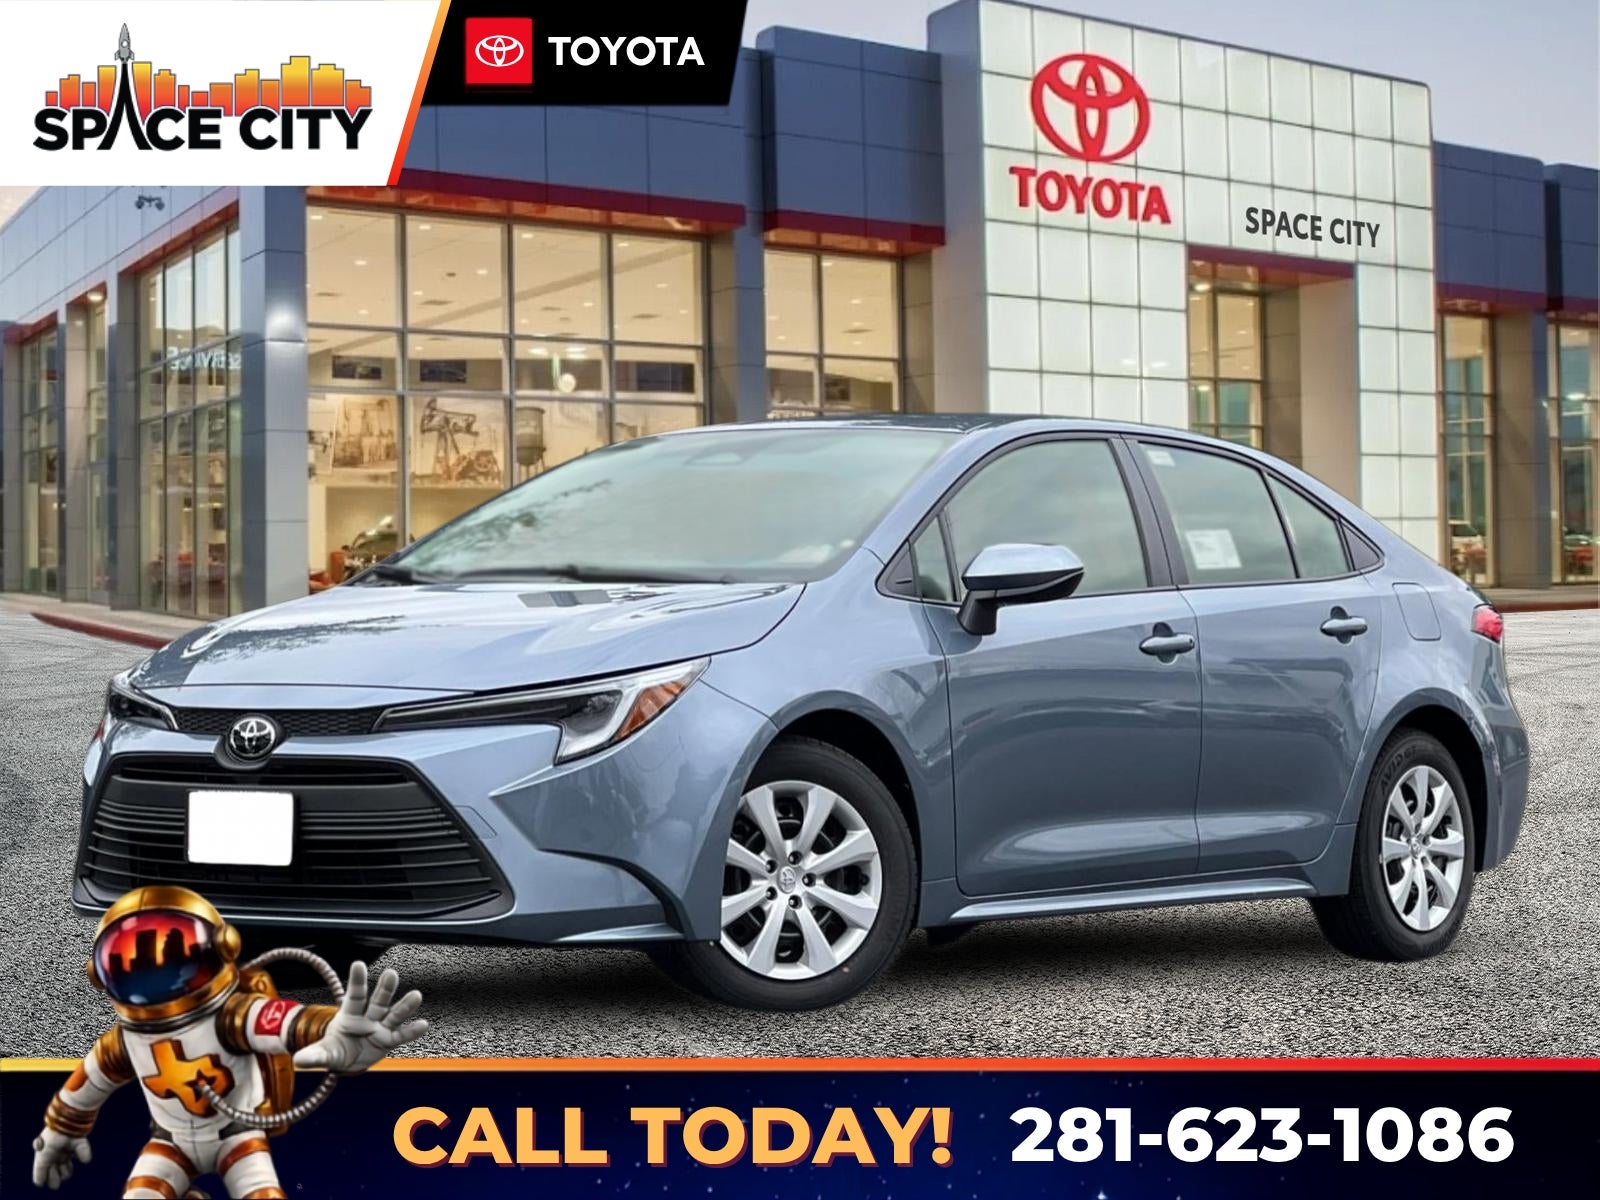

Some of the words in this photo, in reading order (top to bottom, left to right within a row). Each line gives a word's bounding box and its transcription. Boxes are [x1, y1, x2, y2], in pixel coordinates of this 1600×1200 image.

[1010, 165, 1171, 224] TOYOTA
[1245, 206, 1323, 243] SPACE
[1329, 218, 1381, 249] CITY
